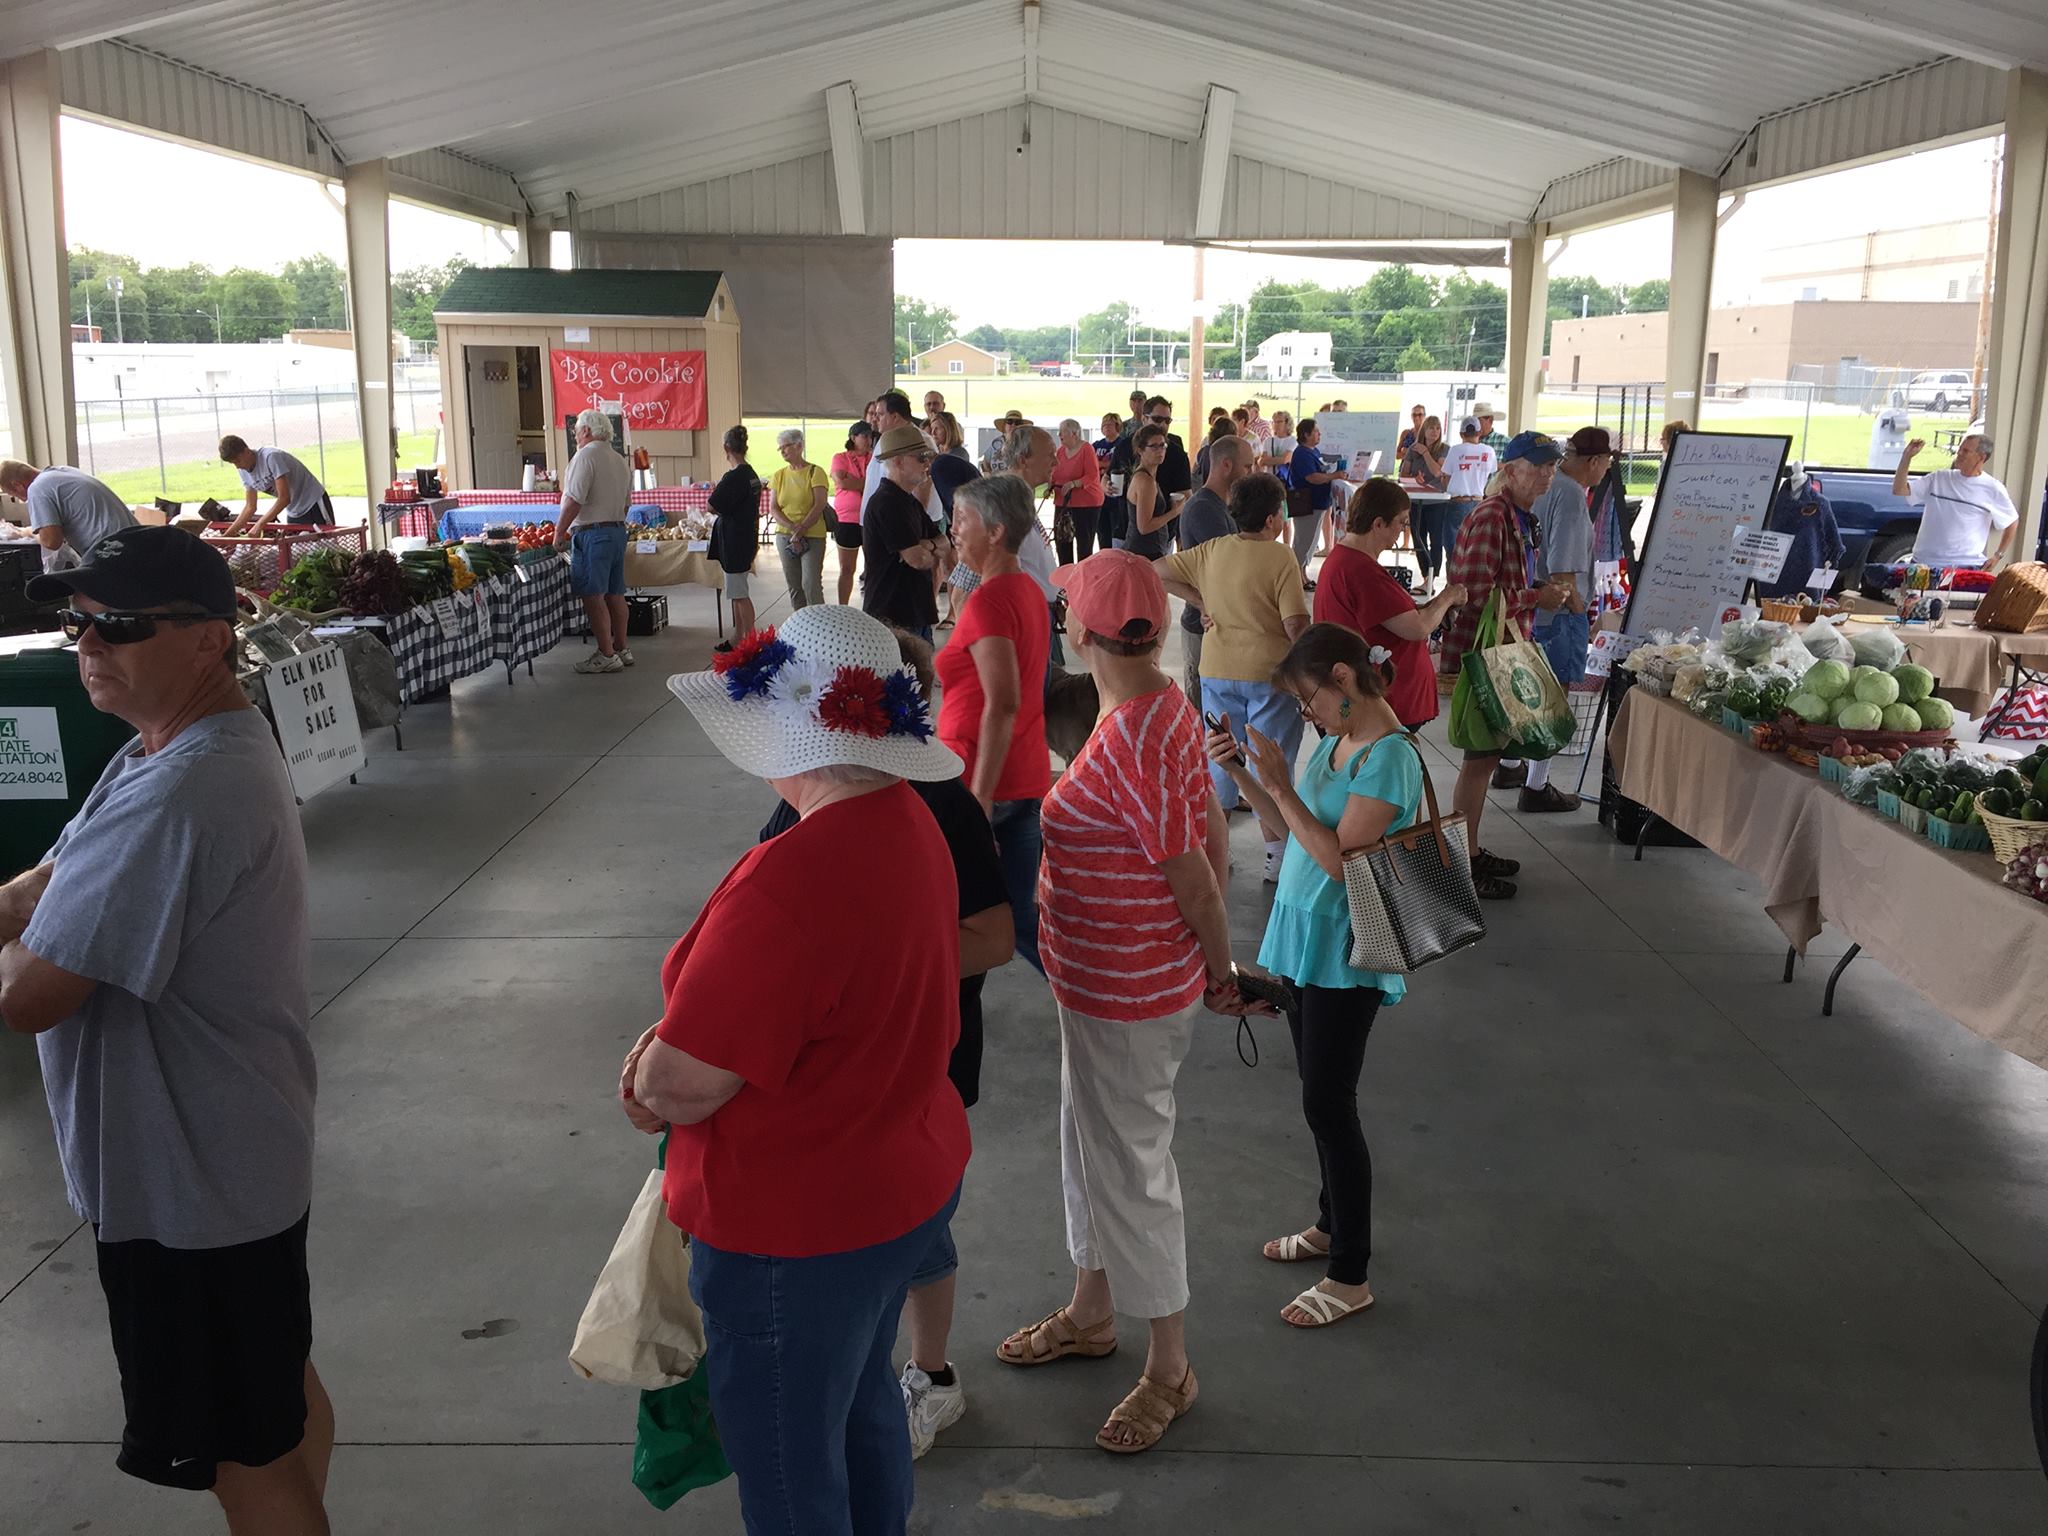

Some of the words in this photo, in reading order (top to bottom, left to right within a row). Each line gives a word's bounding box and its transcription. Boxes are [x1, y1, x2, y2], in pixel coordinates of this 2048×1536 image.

[560, 356, 603, 390] Big
[610, 357, 695, 385] Cookie
[281, 662, 305, 686] ELK
[308, 649, 338, 676] MEAT
[302, 681, 326, 706] FOR
[305, 706, 337, 735] SALE
